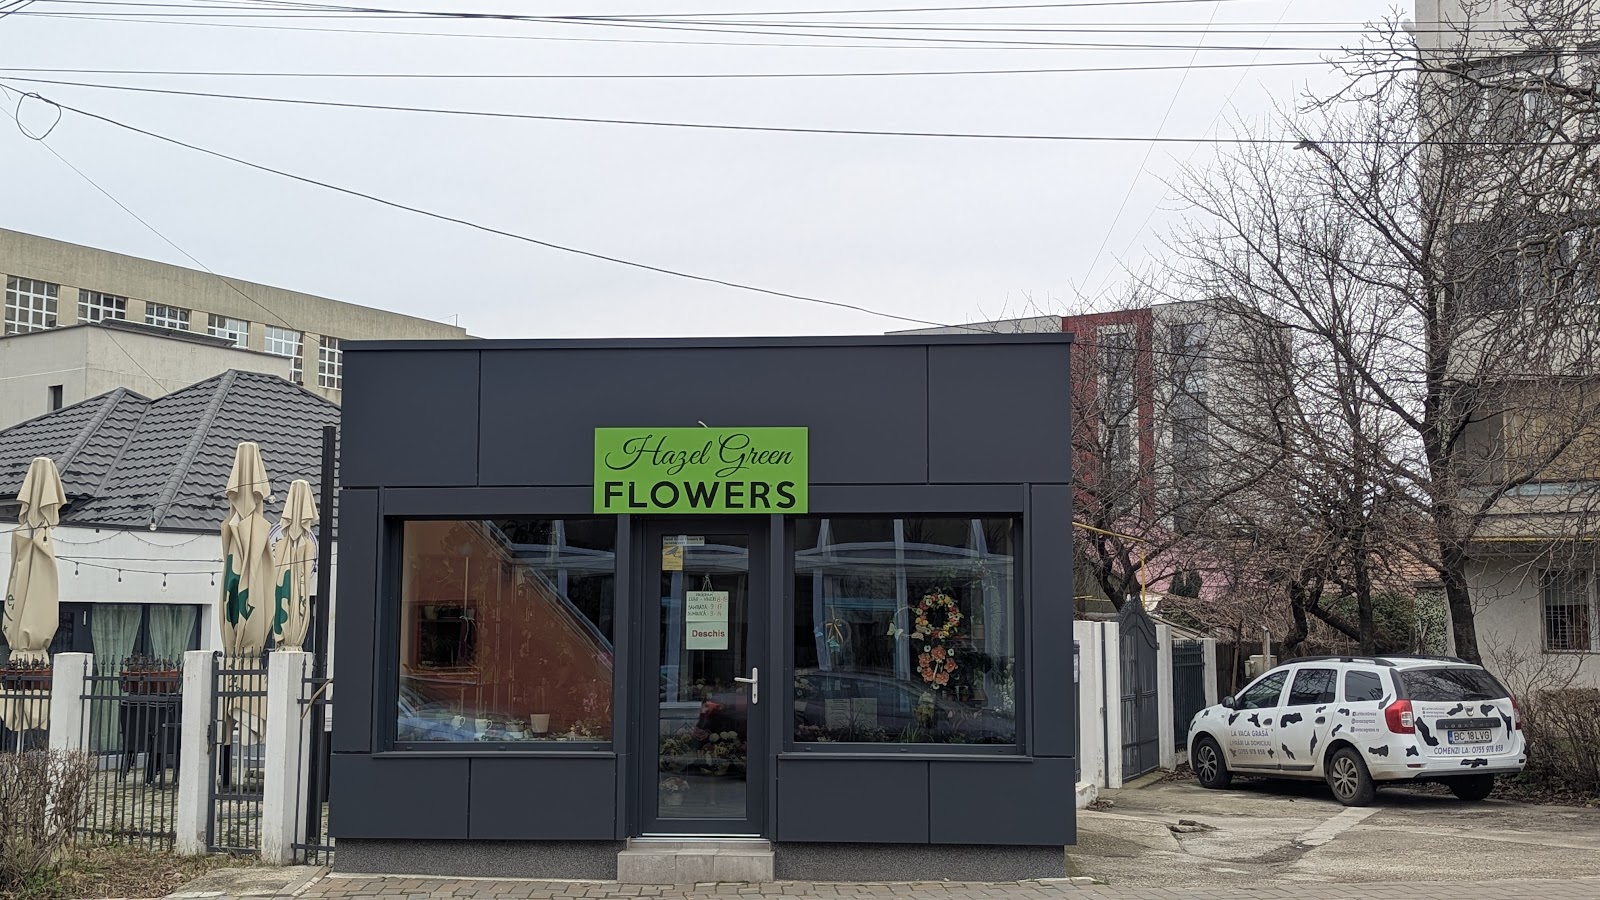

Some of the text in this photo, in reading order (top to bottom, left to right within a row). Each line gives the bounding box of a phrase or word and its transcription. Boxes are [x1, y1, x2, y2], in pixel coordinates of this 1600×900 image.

[605, 433, 794, 478] Hazel Green
[604, 481, 796, 509] FLOWERS
[692, 629, 725, 638] Deschis
[1454, 731, 1490, 741] BC 18 LVG
[1433, 747, 1460, 755] COMENZI
[1472, 745, 1485, 754] 0755
[1486, 744, 1494, 753] 978
